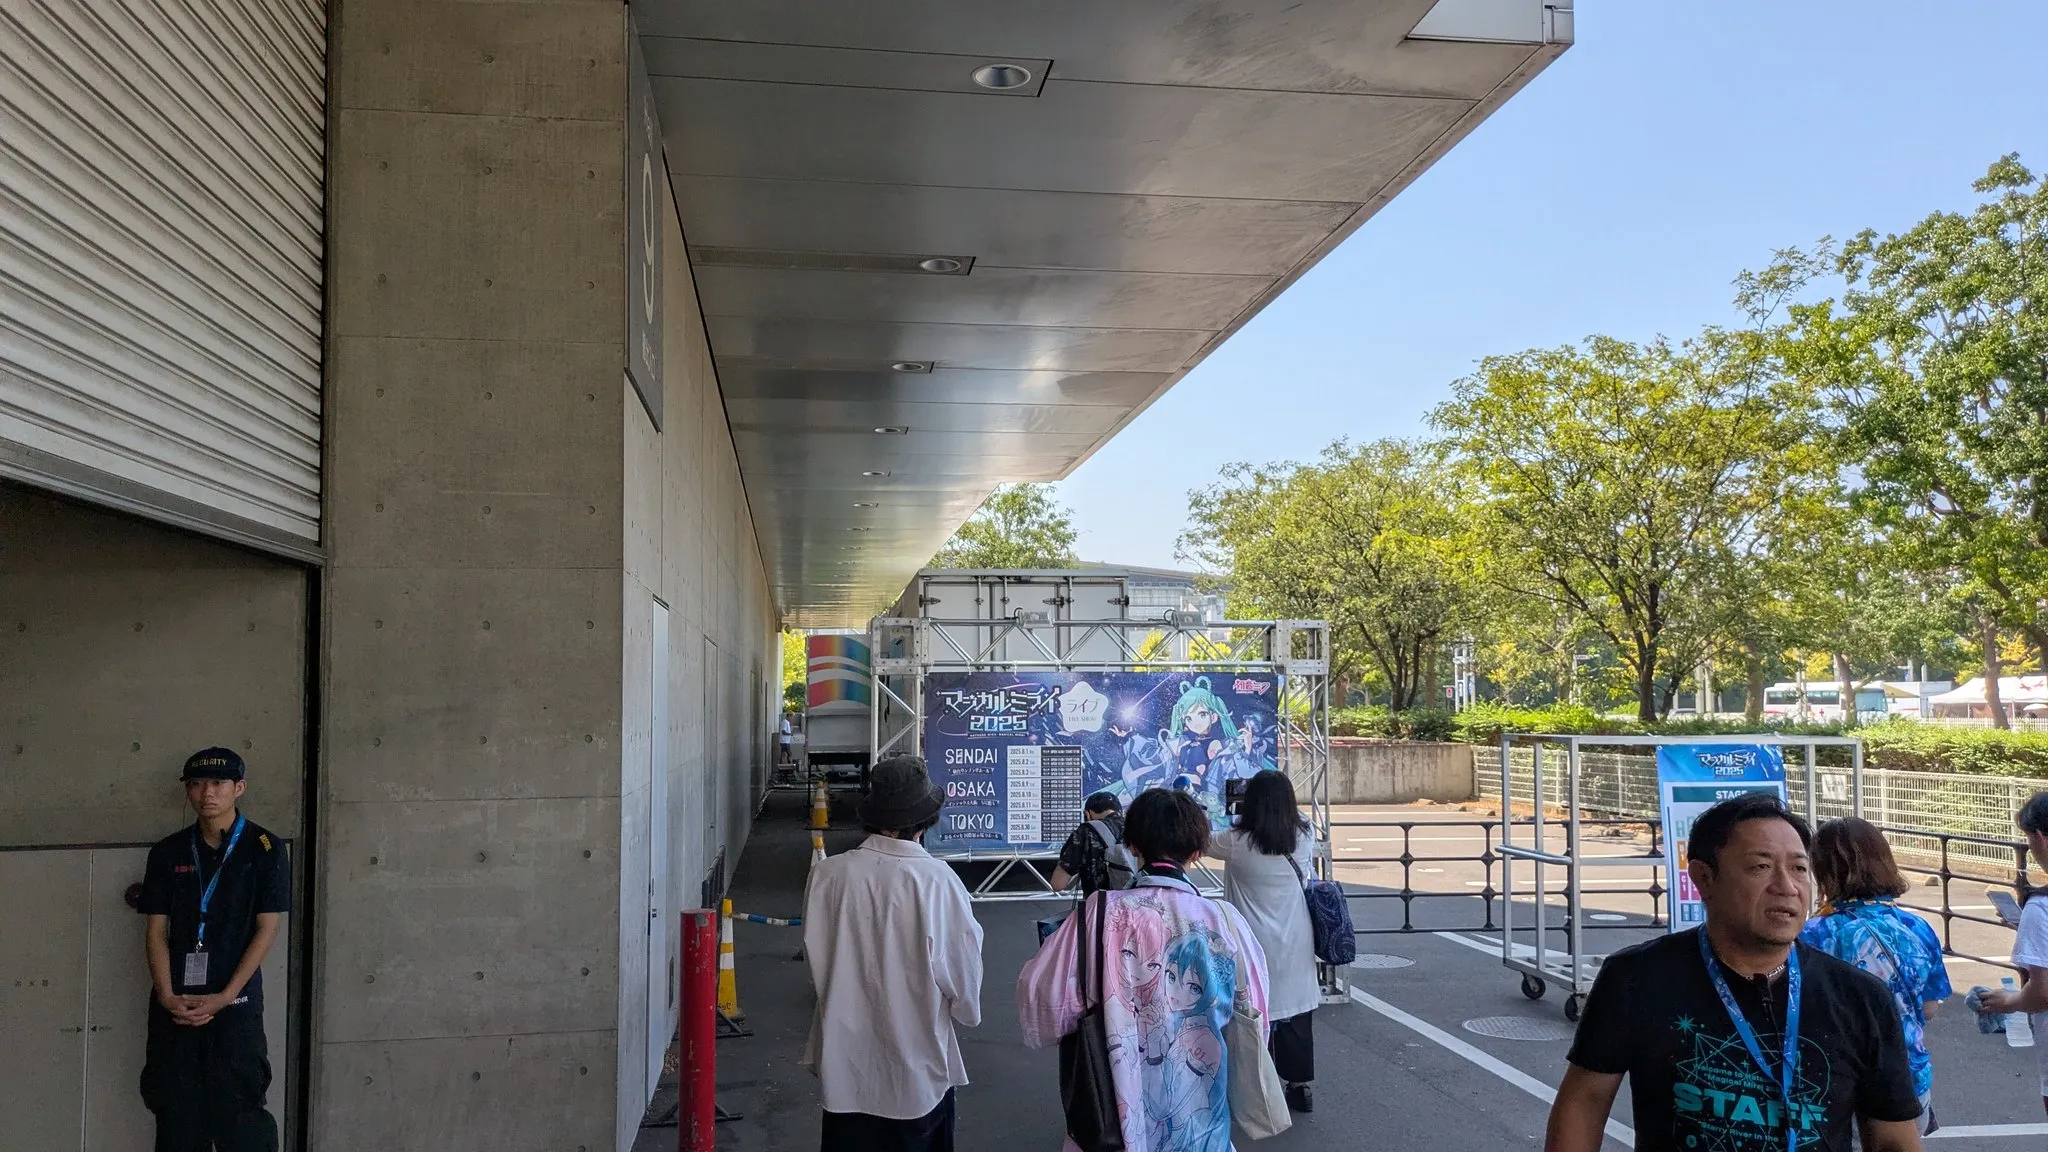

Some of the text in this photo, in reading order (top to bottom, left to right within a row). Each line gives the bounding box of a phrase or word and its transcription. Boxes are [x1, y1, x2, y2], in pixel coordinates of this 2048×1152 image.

[643, 153, 654, 324] 9
[1067, 698, 1100, 713] ライブ
[970, 715, 1027, 731] 2025
[945, 748, 998, 765] SENDAI
[1715, 766, 1744, 776] 2025
[947, 781, 996, 798] OSAKA
[948, 813, 994, 830] TOKYO
